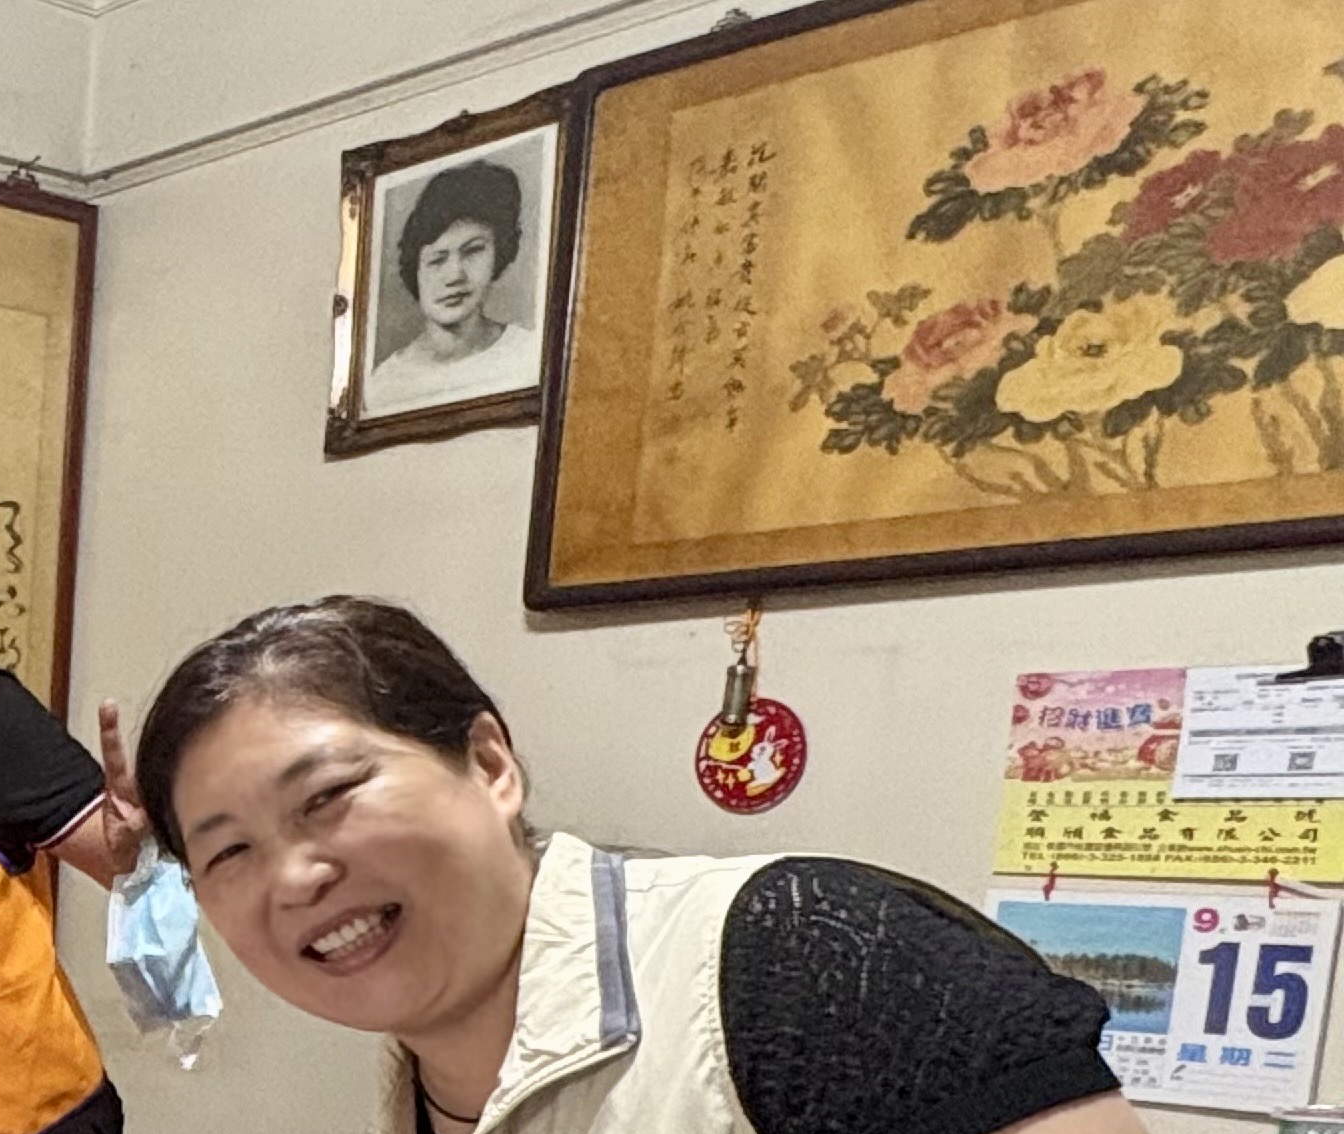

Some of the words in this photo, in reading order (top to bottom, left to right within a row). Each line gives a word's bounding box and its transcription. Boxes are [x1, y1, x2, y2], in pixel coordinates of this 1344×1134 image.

[1192, 908, 1220, 934] 9
[1198, 941, 1314, 1041] 15
[1176, 1043, 1297, 1070] 星期二
